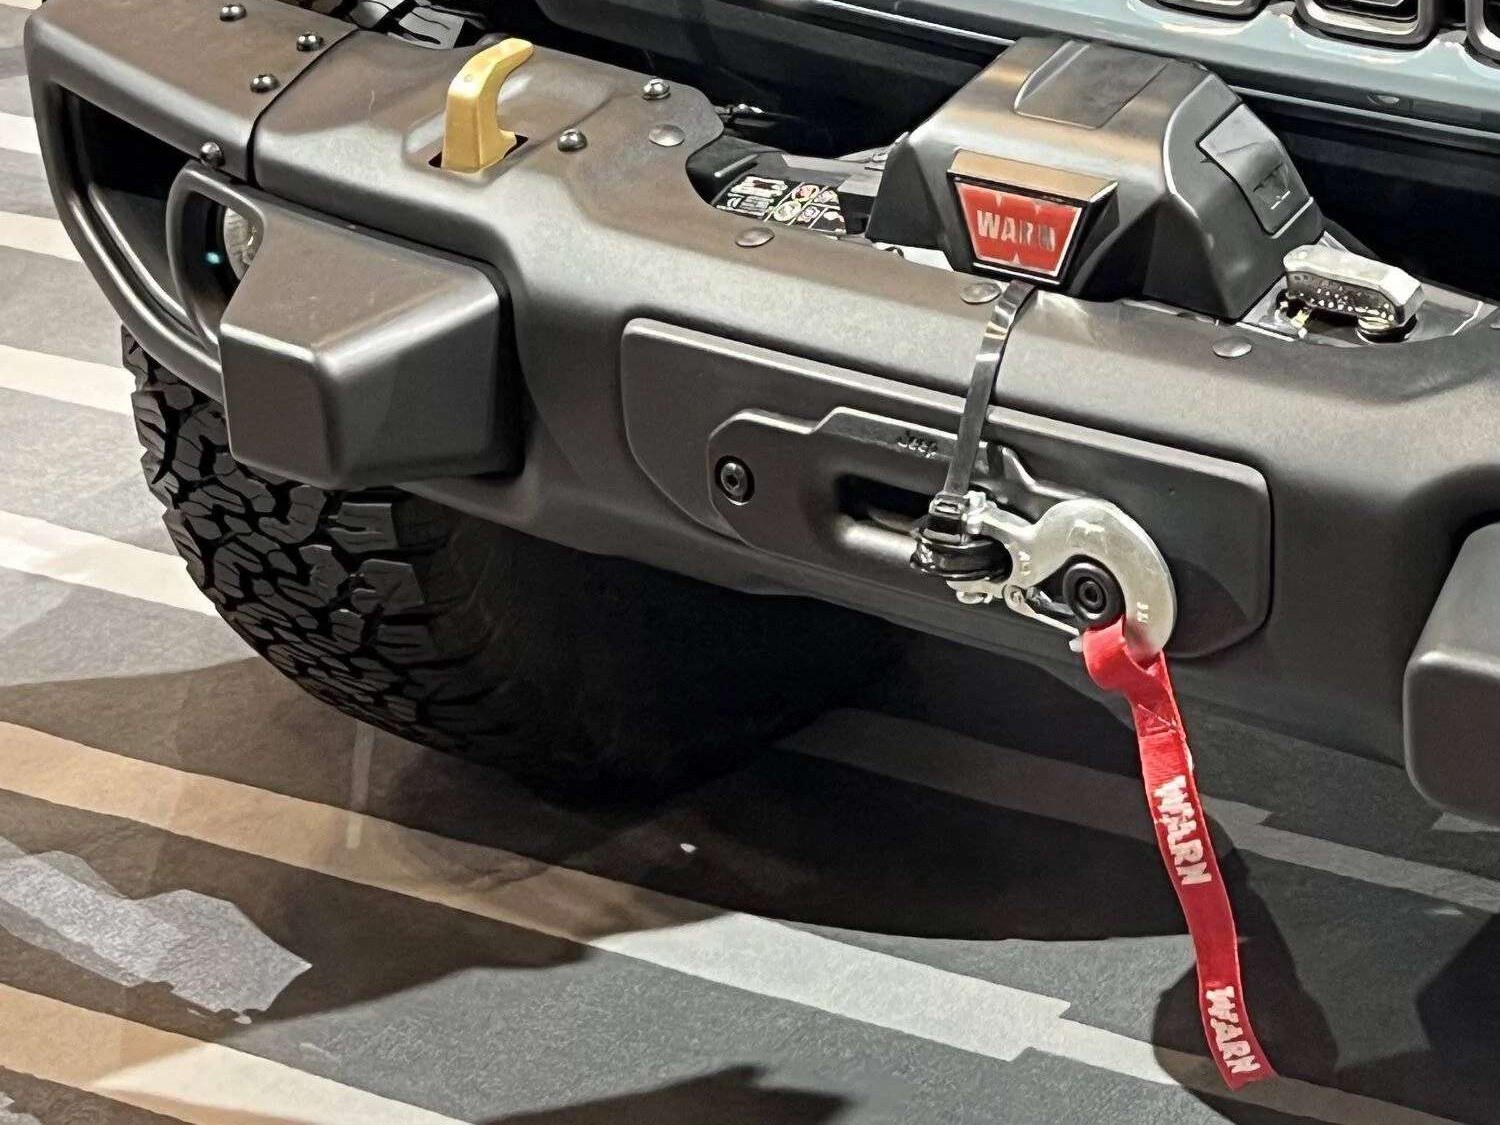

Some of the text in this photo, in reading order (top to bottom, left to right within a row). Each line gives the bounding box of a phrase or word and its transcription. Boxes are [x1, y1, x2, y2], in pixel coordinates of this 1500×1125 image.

[976, 209, 1057, 253] WARN
[1153, 775, 1212, 885] WARN
[1206, 986, 1261, 1073] WARN
